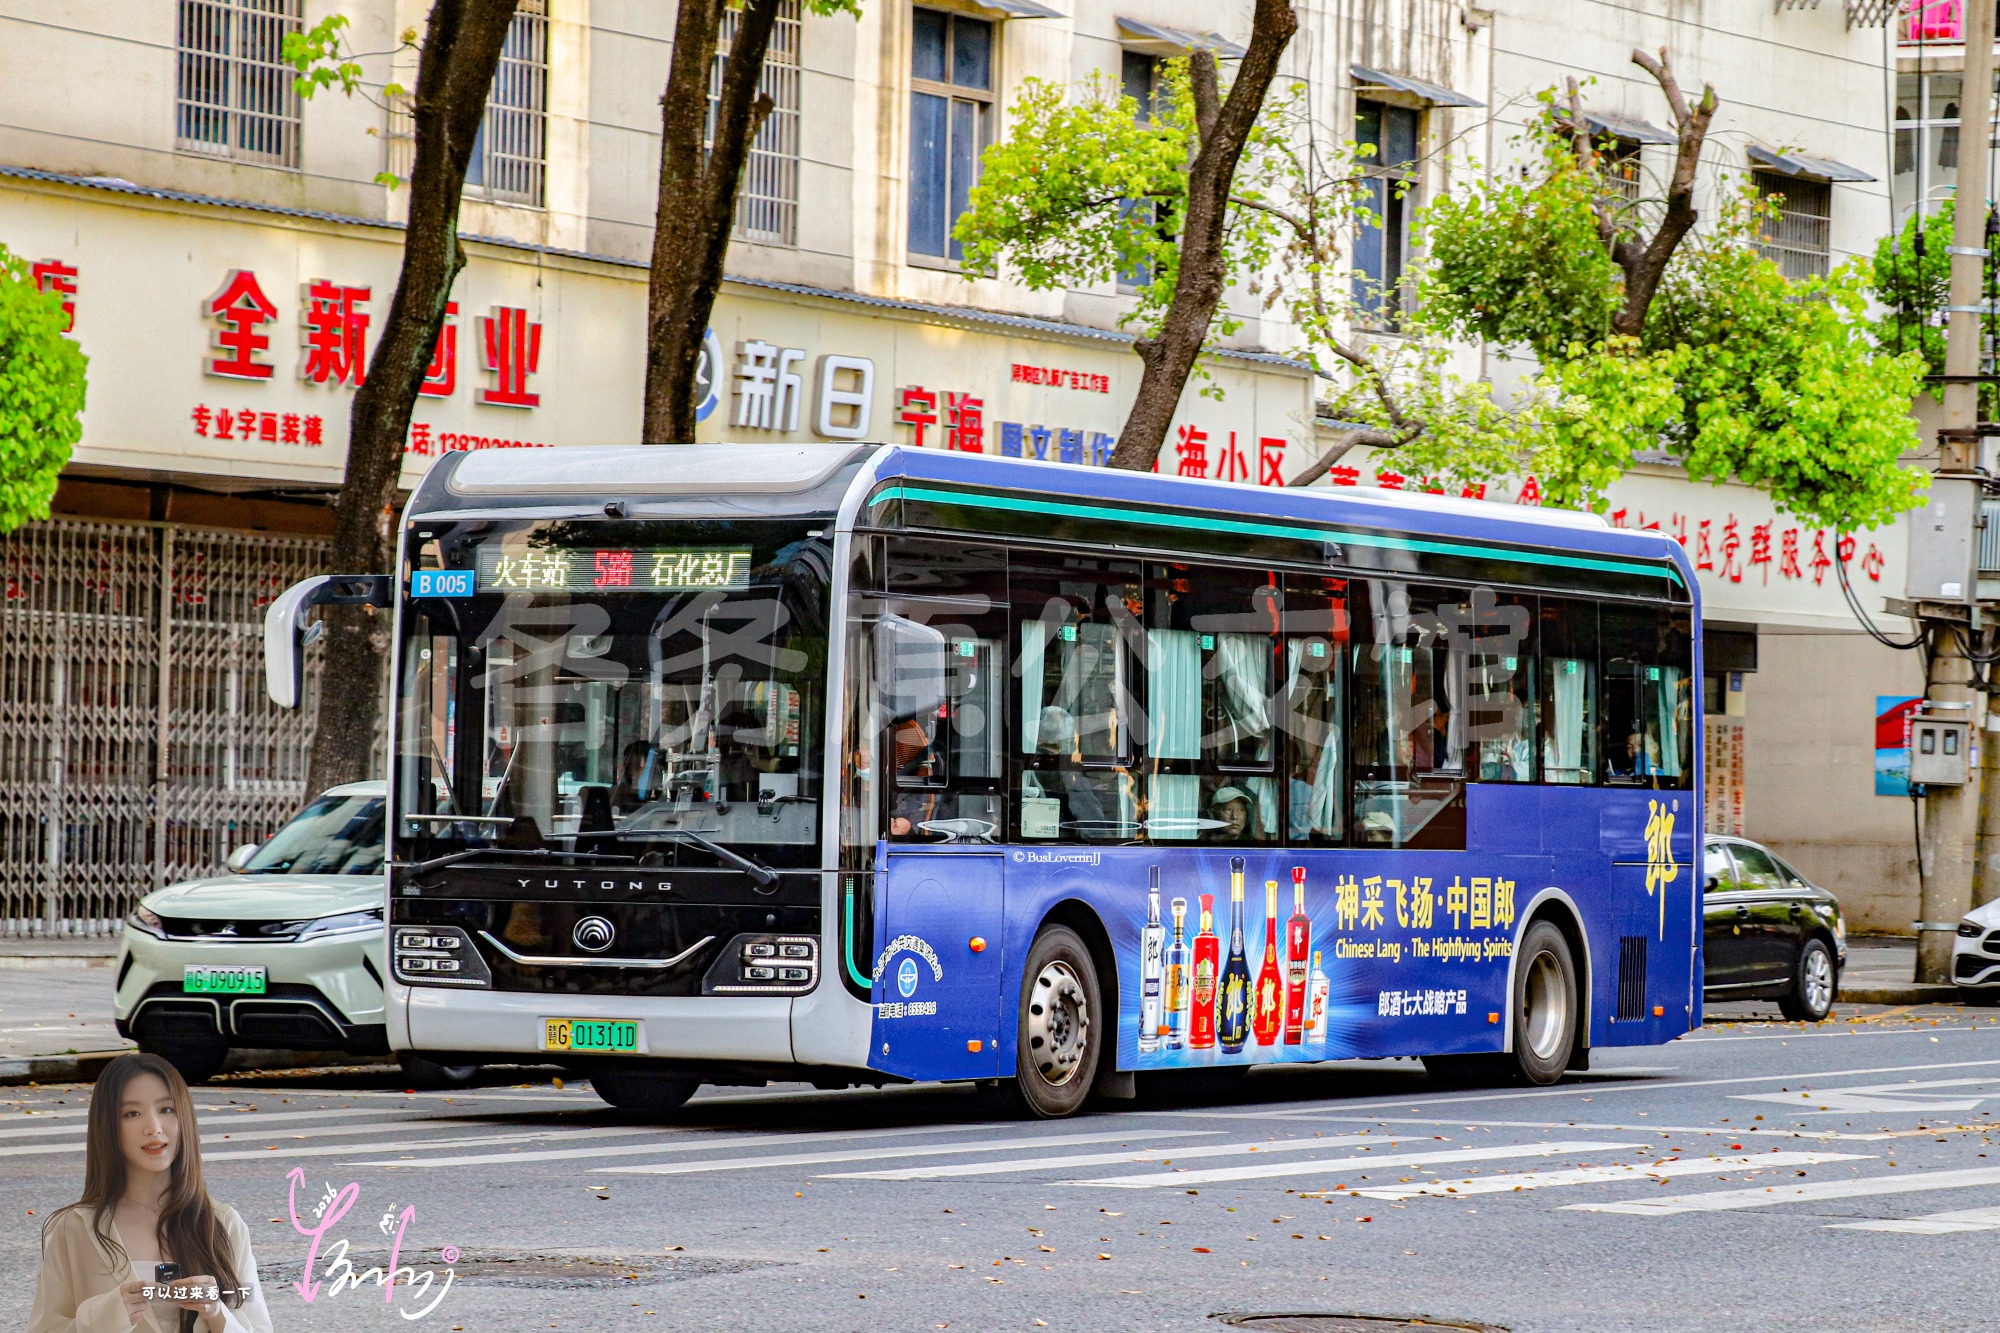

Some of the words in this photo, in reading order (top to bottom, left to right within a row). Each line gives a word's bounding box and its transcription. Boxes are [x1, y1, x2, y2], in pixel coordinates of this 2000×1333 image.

[735, 340, 875, 438] 新日
[192, 403, 323, 447] 专业字画装裱
[1152, 424, 1287, 488] 海小区
[419, 577, 431, 594] B
[436, 575, 467, 593] 005
[492, 552, 568, 588] 火车站
[594, 550, 634, 588] 5路
[651, 553, 751, 587] 石化总厂
[518, 879, 672, 891] YUTONG
[1335, 874, 1516, 931] 神采飞扬·中国郎
[1335, 938, 1374, 959] Chinese
[1377, 938, 1401, 964] Lang
[1411, 937, 1430, 957] The
[1432, 936, 1482, 962] Highflying
[1483, 937, 1513, 962] Spirits
[1378, 990, 1467, 1016] 郎酒七大战略产品
